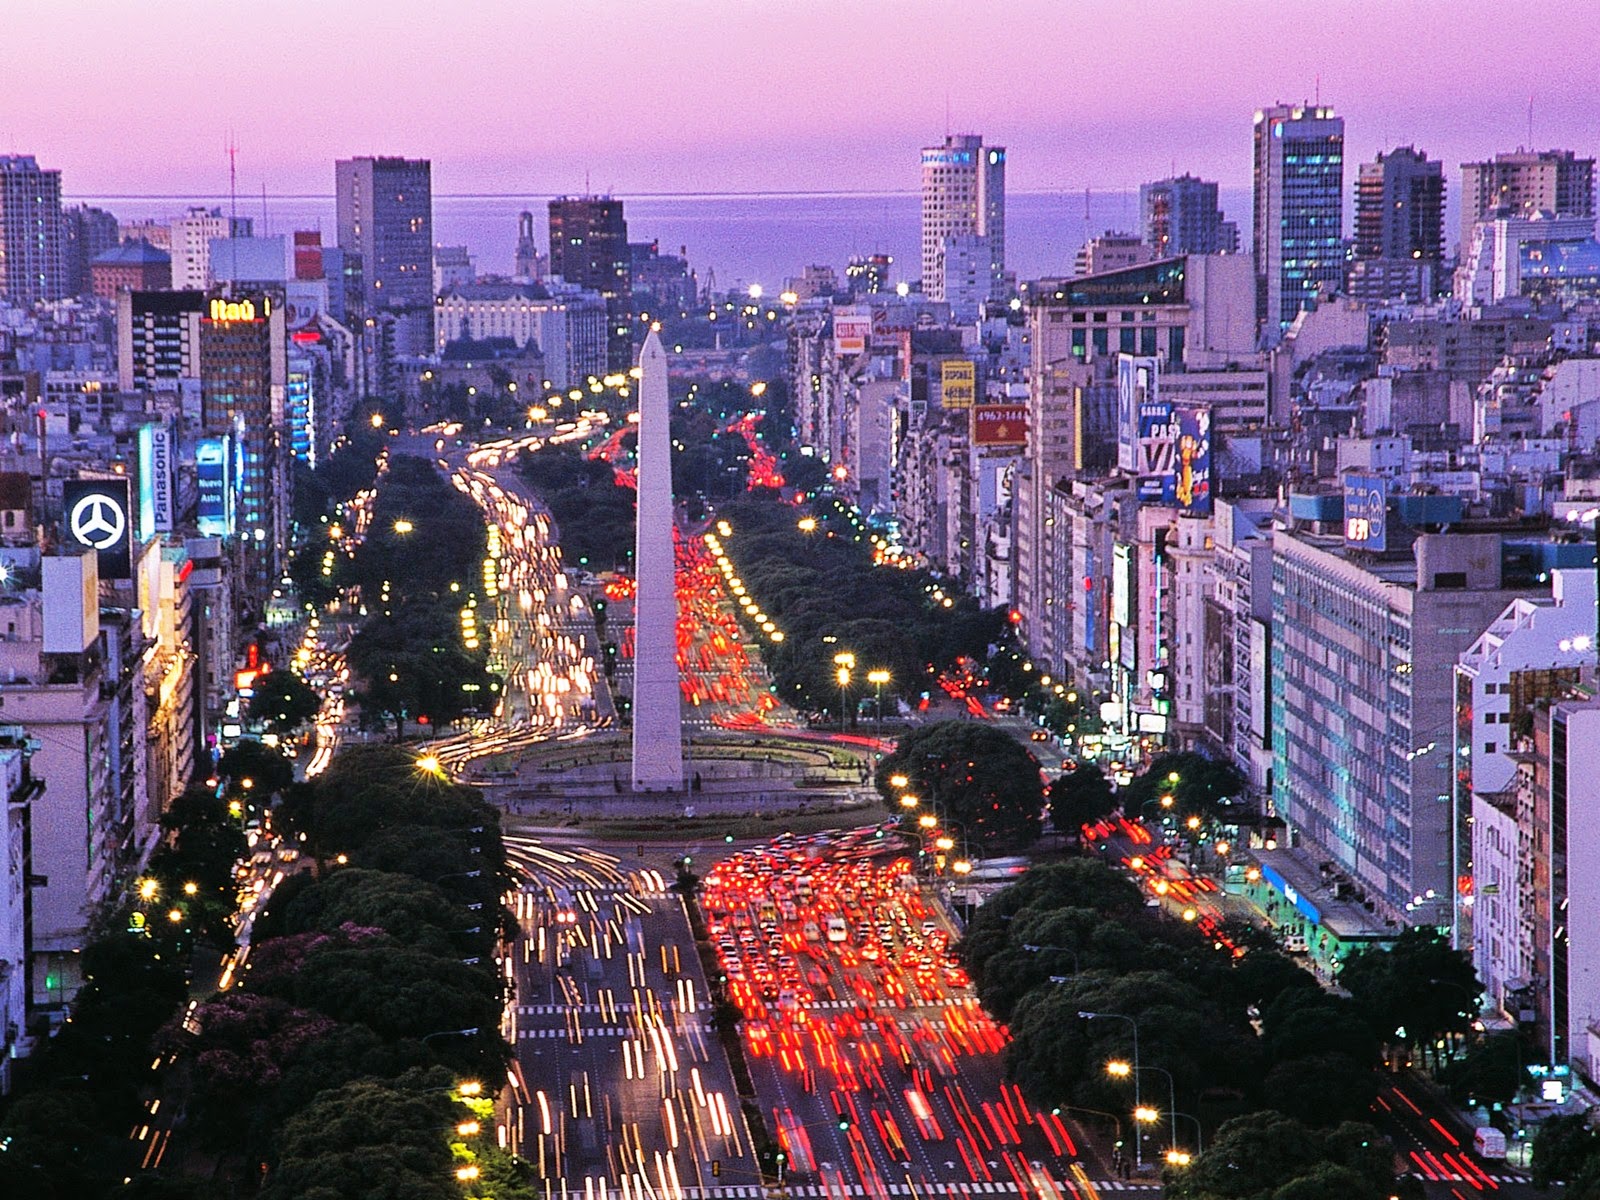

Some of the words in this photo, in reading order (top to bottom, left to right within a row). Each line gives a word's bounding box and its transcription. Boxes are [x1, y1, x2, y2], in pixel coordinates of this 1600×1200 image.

[153, 432, 168, 524] Panasonic
[198, 479, 223, 488] Nuevo
[200, 494, 221, 503] Astra
